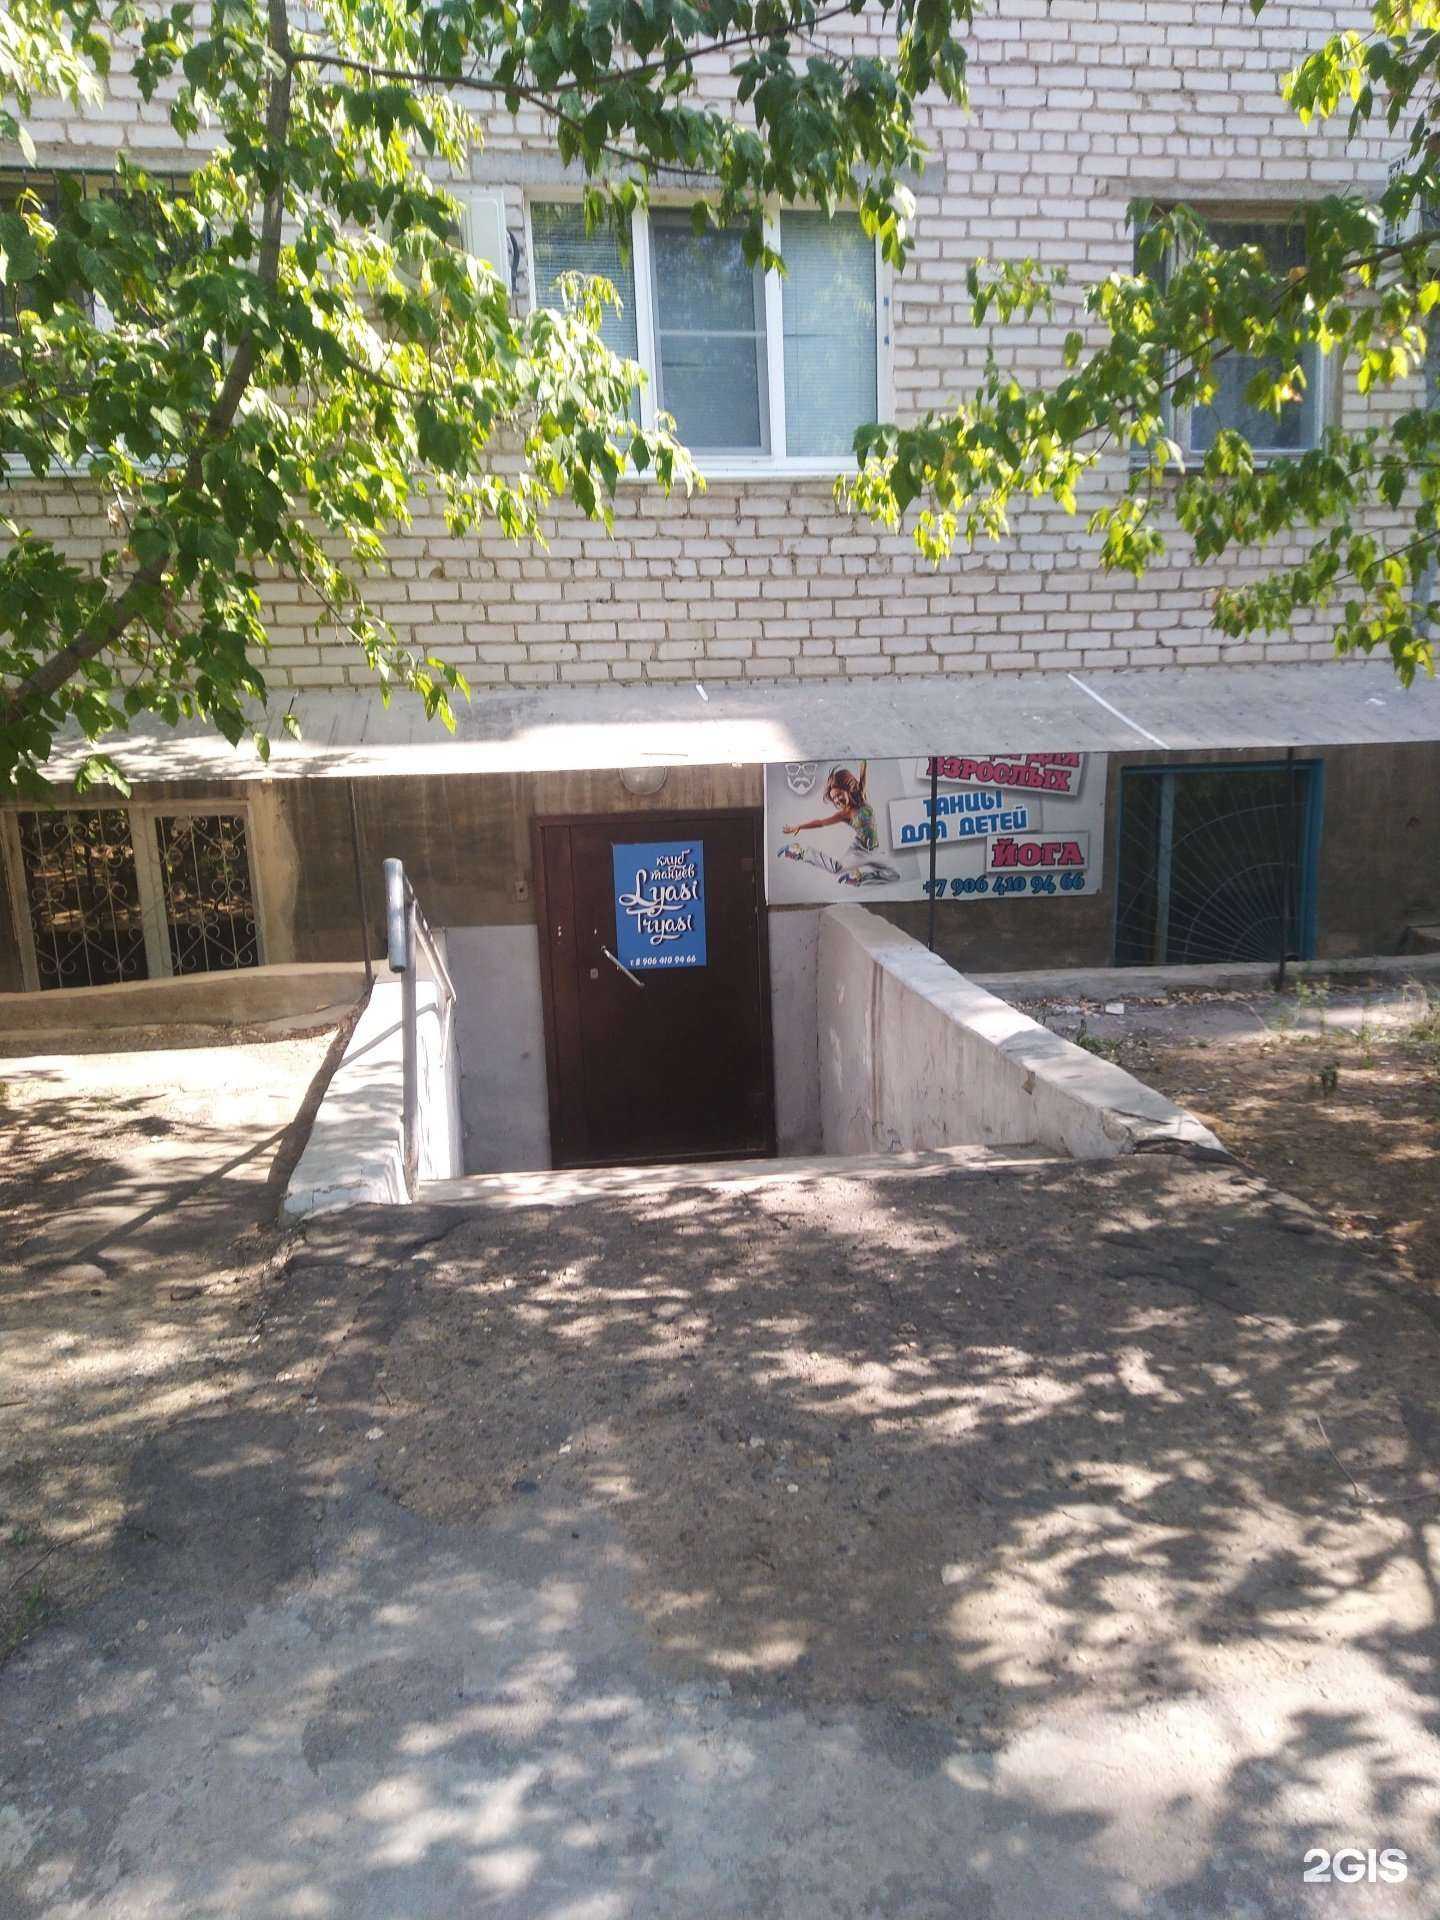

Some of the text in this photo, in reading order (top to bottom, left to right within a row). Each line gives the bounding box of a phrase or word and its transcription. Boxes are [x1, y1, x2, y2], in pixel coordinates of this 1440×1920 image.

[923, 790, 1003, 817] ТАНЦЫ
[901, 804, 1028, 843] ДЛЯ ДЕТЕЙ
[991, 838, 1085, 867] ЙОГА
[619, 869, 698, 917] Lyasi
[951, 875, 989, 897] 906
[992, 875, 1027, 896] 410
[1030, 874, 1057, 894] 94
[1060, 872, 1085, 891] 66
